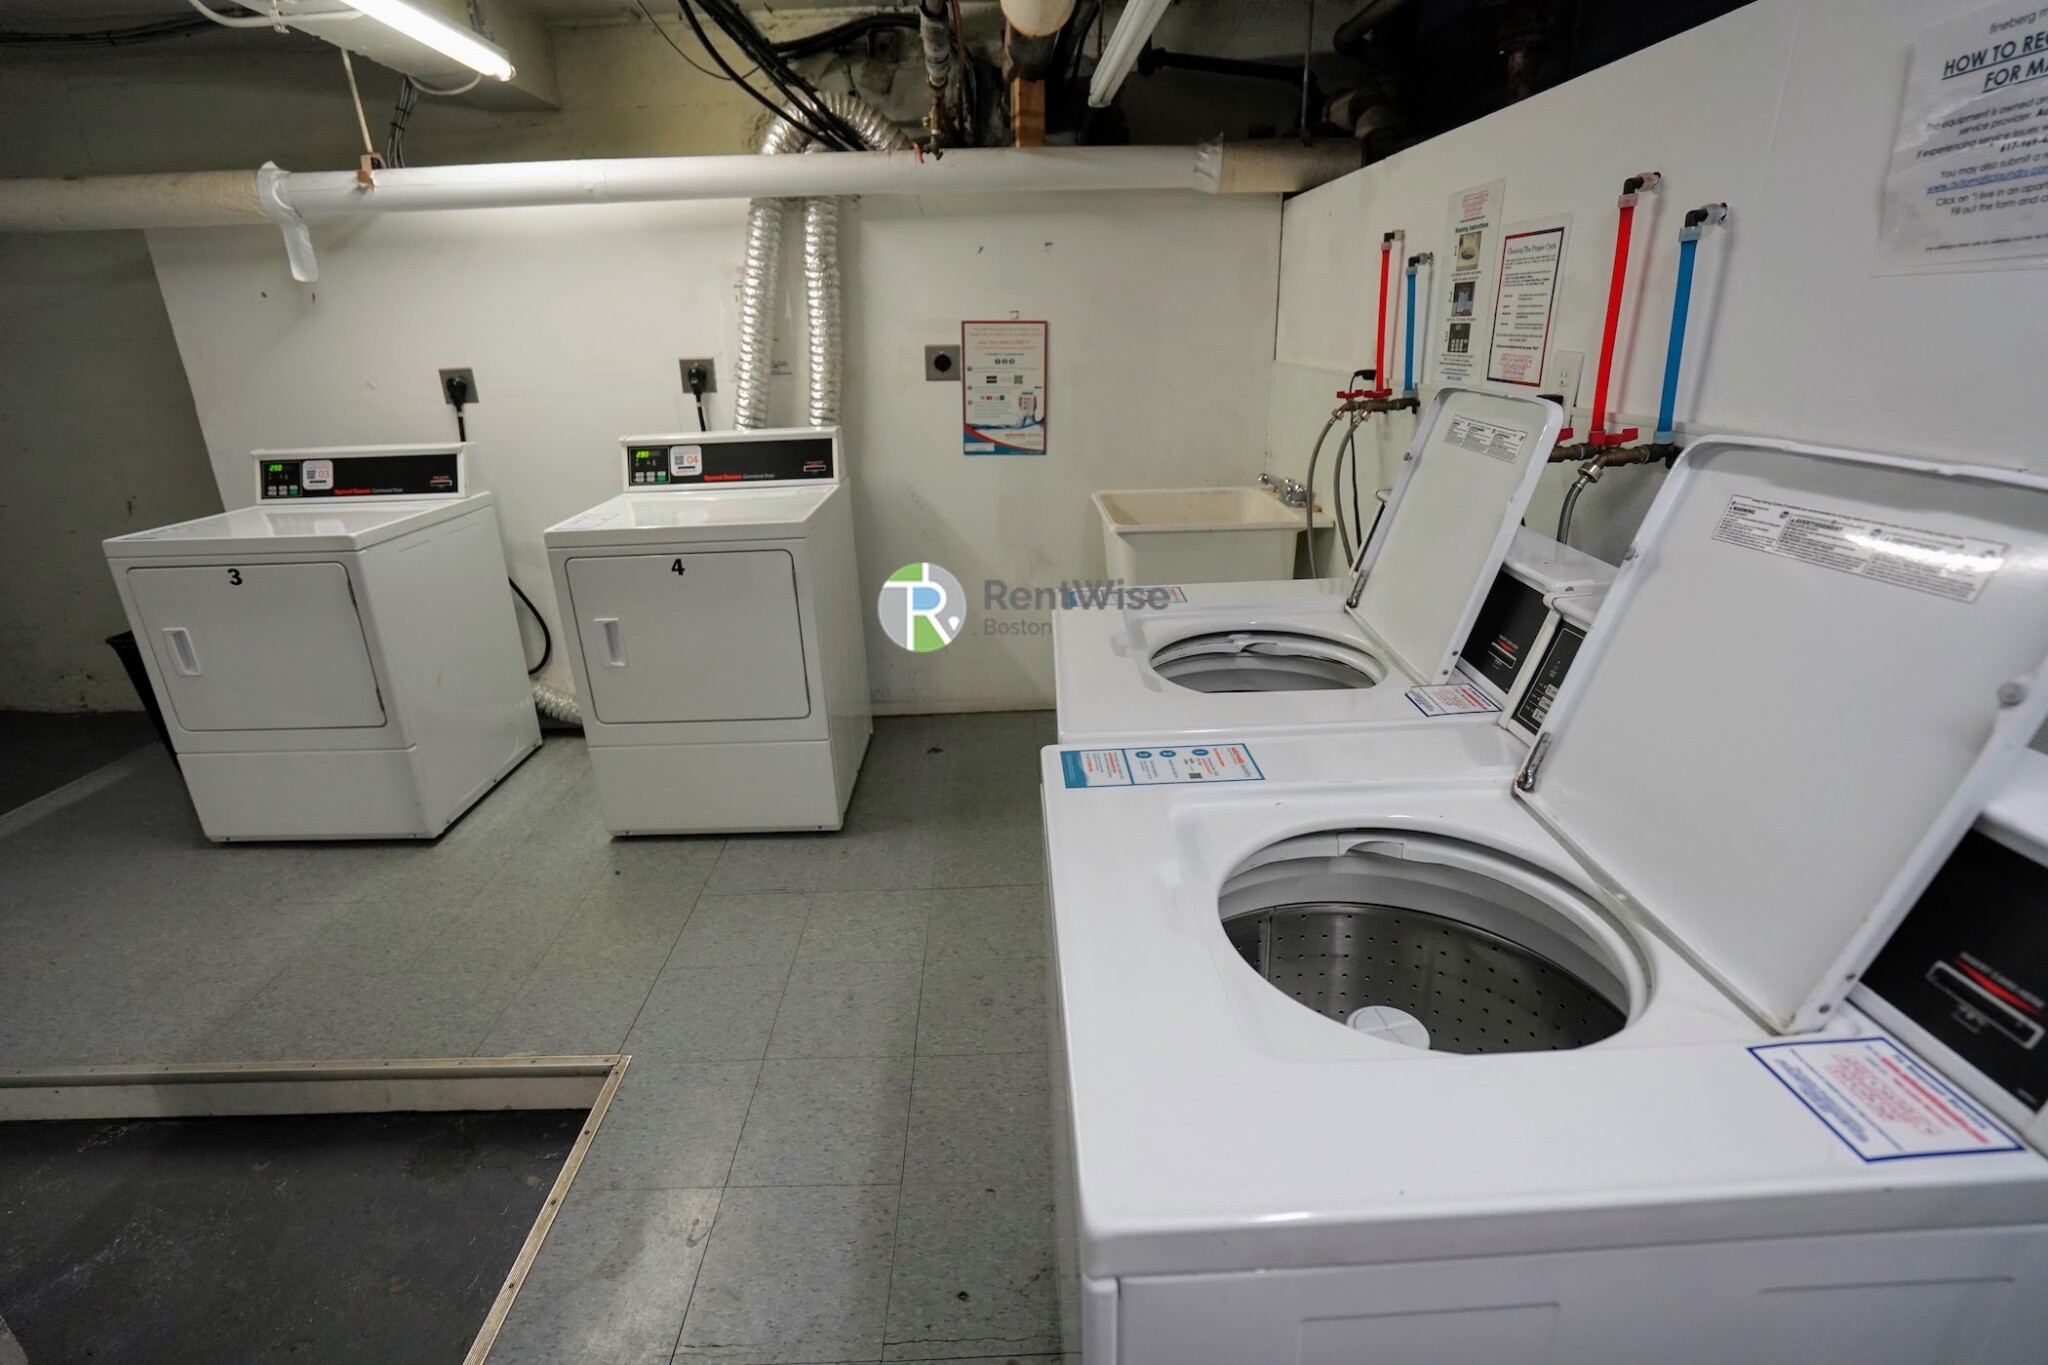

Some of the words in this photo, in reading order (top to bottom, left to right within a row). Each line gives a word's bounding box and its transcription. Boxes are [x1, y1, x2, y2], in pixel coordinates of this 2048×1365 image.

[1943, 48, 1988, 77] HOW
[1993, 41, 2017, 62] TO
[1983, 64, 2021, 88] FOR
[1940, 169, 1956, 179] You
[1957, 166, 1978, 177] may
[1978, 161, 1997, 172] also
[1935, 196, 1955, 207] Click
[687, 455, 698, 464] 04
[318, 470, 330, 479] 03
[672, 558, 685, 576] 4
[227, 568, 243, 586] 3
